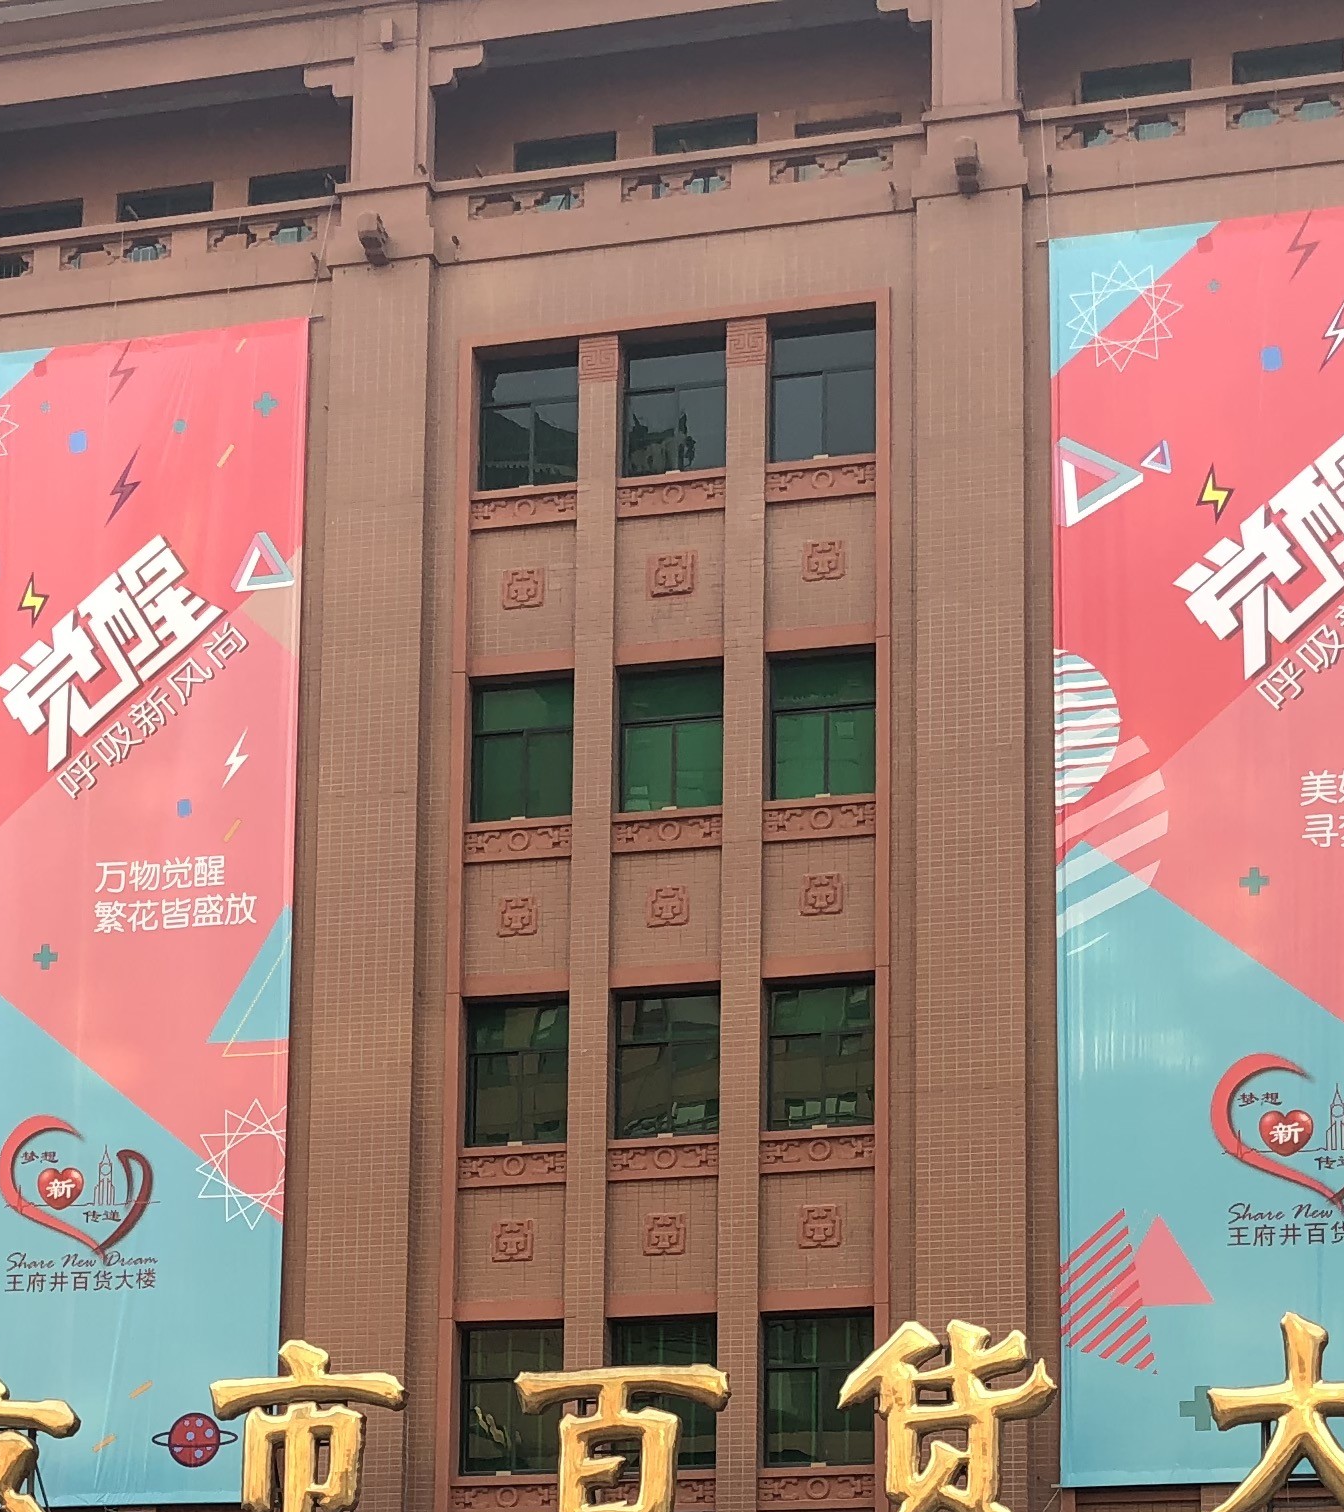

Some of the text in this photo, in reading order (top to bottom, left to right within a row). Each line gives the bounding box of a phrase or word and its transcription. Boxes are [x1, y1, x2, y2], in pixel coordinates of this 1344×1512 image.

[55, 623, 249, 800] 呼吸新风尚
[94, 855, 226, 894] 万物觉醒
[93, 892, 258, 935] 繁花皆盛放
[1237, 1092, 1283, 1108] 梦想
[1268, 1121, 1305, 1145] 新
[21, 1150, 59, 1165] 梦想
[45, 1178, 76, 1200] 新
[82, 1209, 122, 1224] 传递
[1227, 1202, 1286, 1225] Share
[1292, 1203, 1334, 1220] New
[6, 1250, 159, 1273] Share New Dream
[4, 1267, 157, 1293] 王府井百货大楼
